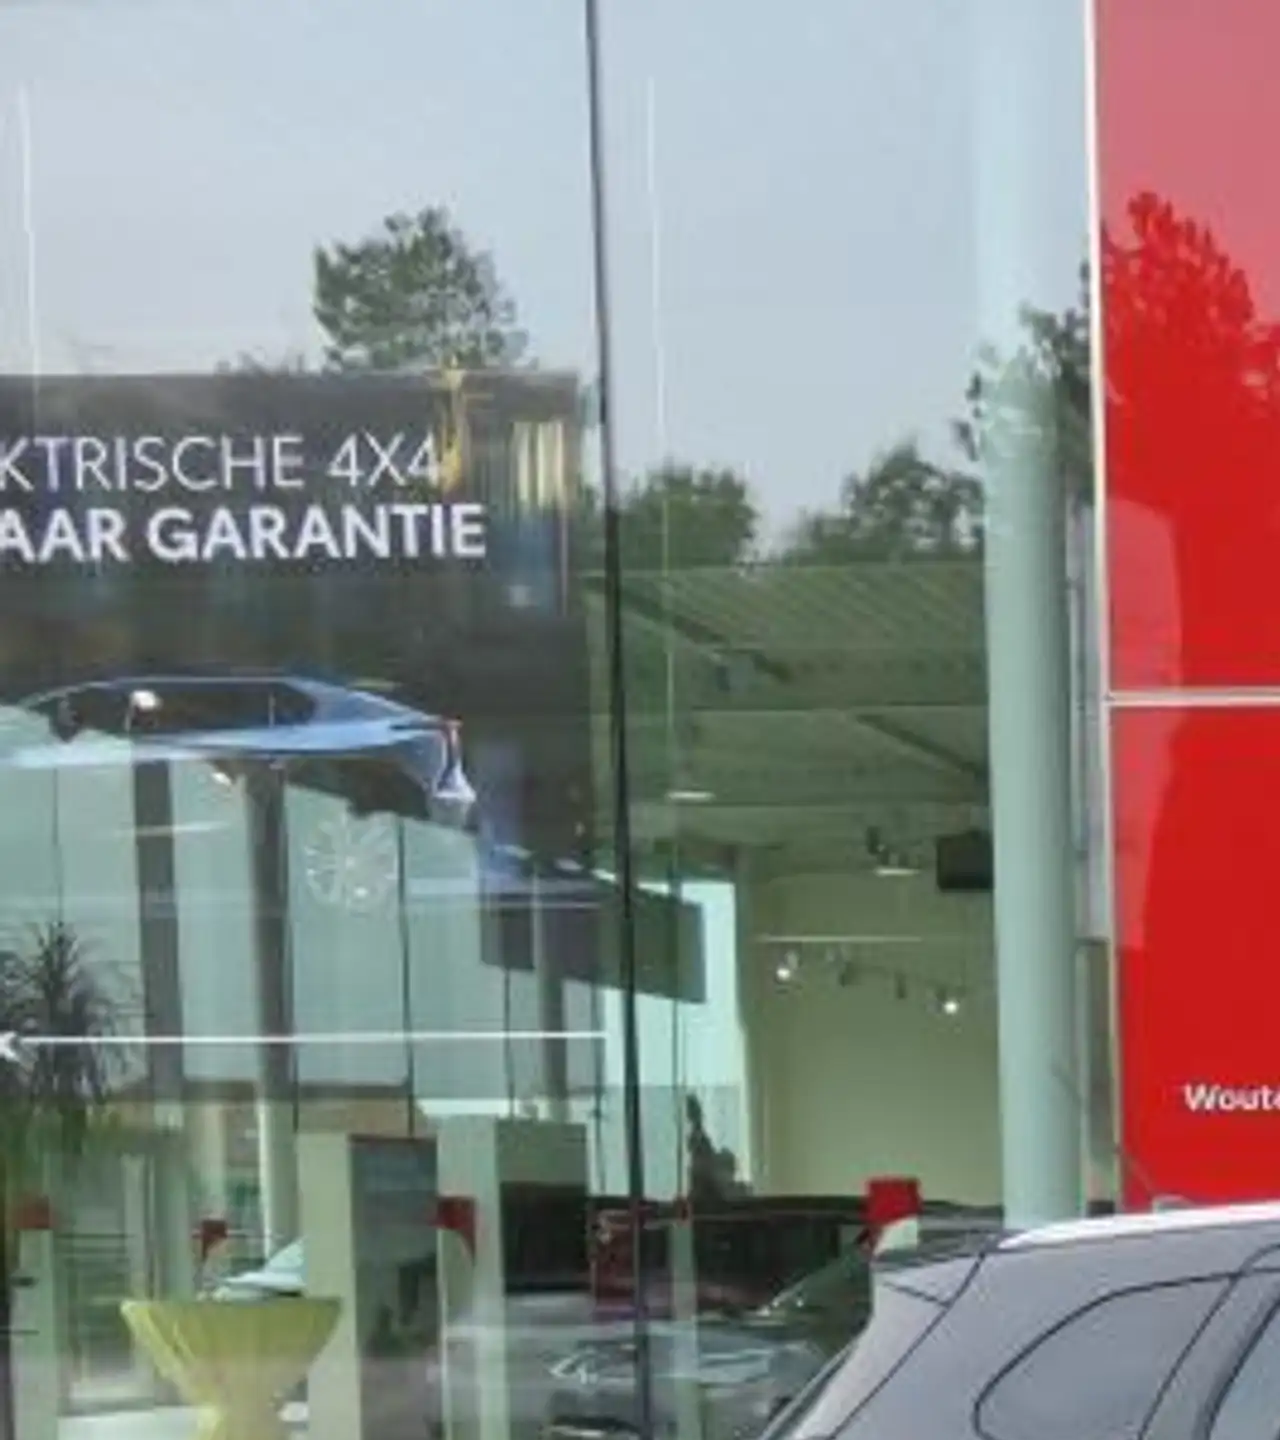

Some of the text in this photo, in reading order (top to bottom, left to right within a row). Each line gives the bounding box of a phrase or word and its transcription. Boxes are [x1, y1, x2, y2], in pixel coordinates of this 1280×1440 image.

[0, 429, 441, 492] KTRISCHE 4X4
[0, 503, 487, 564] AAR GARANTIE
